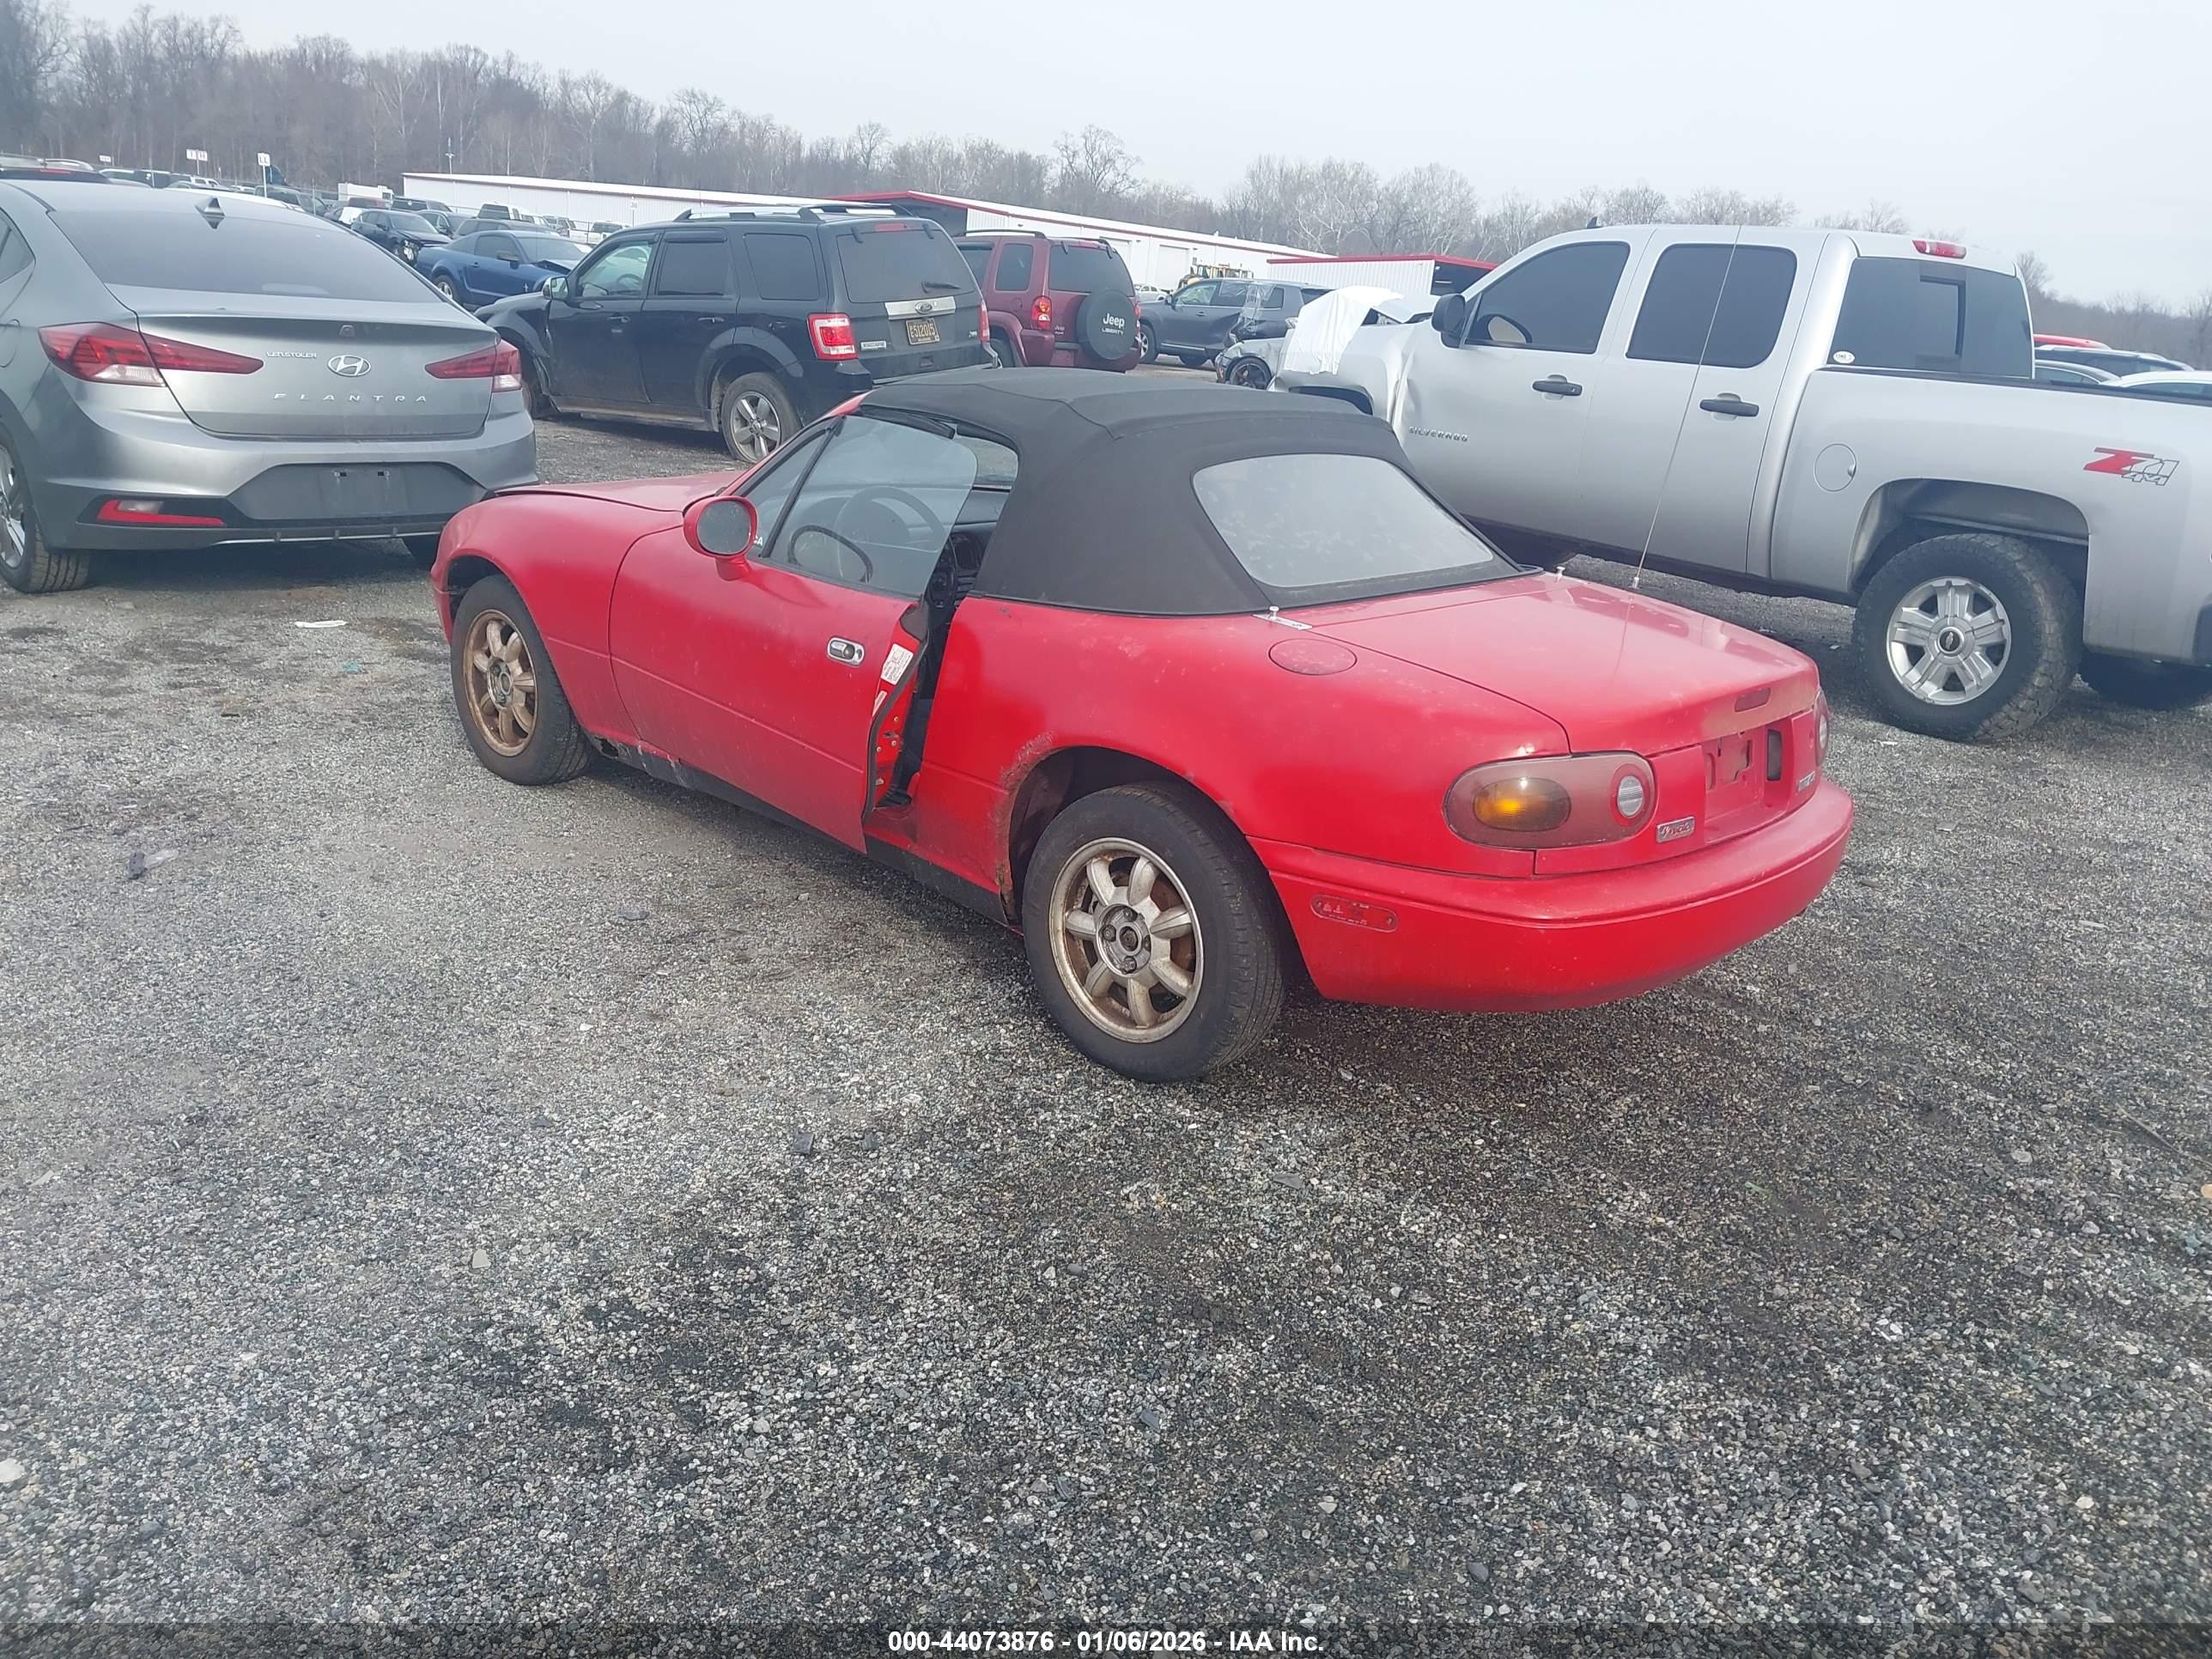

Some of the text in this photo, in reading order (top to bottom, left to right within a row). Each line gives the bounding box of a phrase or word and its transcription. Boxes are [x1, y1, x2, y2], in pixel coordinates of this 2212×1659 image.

[1103, 313, 1125, 329] Jeep
[1408, 426, 1468, 442] SILVERADO
[2082, 447, 2179, 478] Z71
